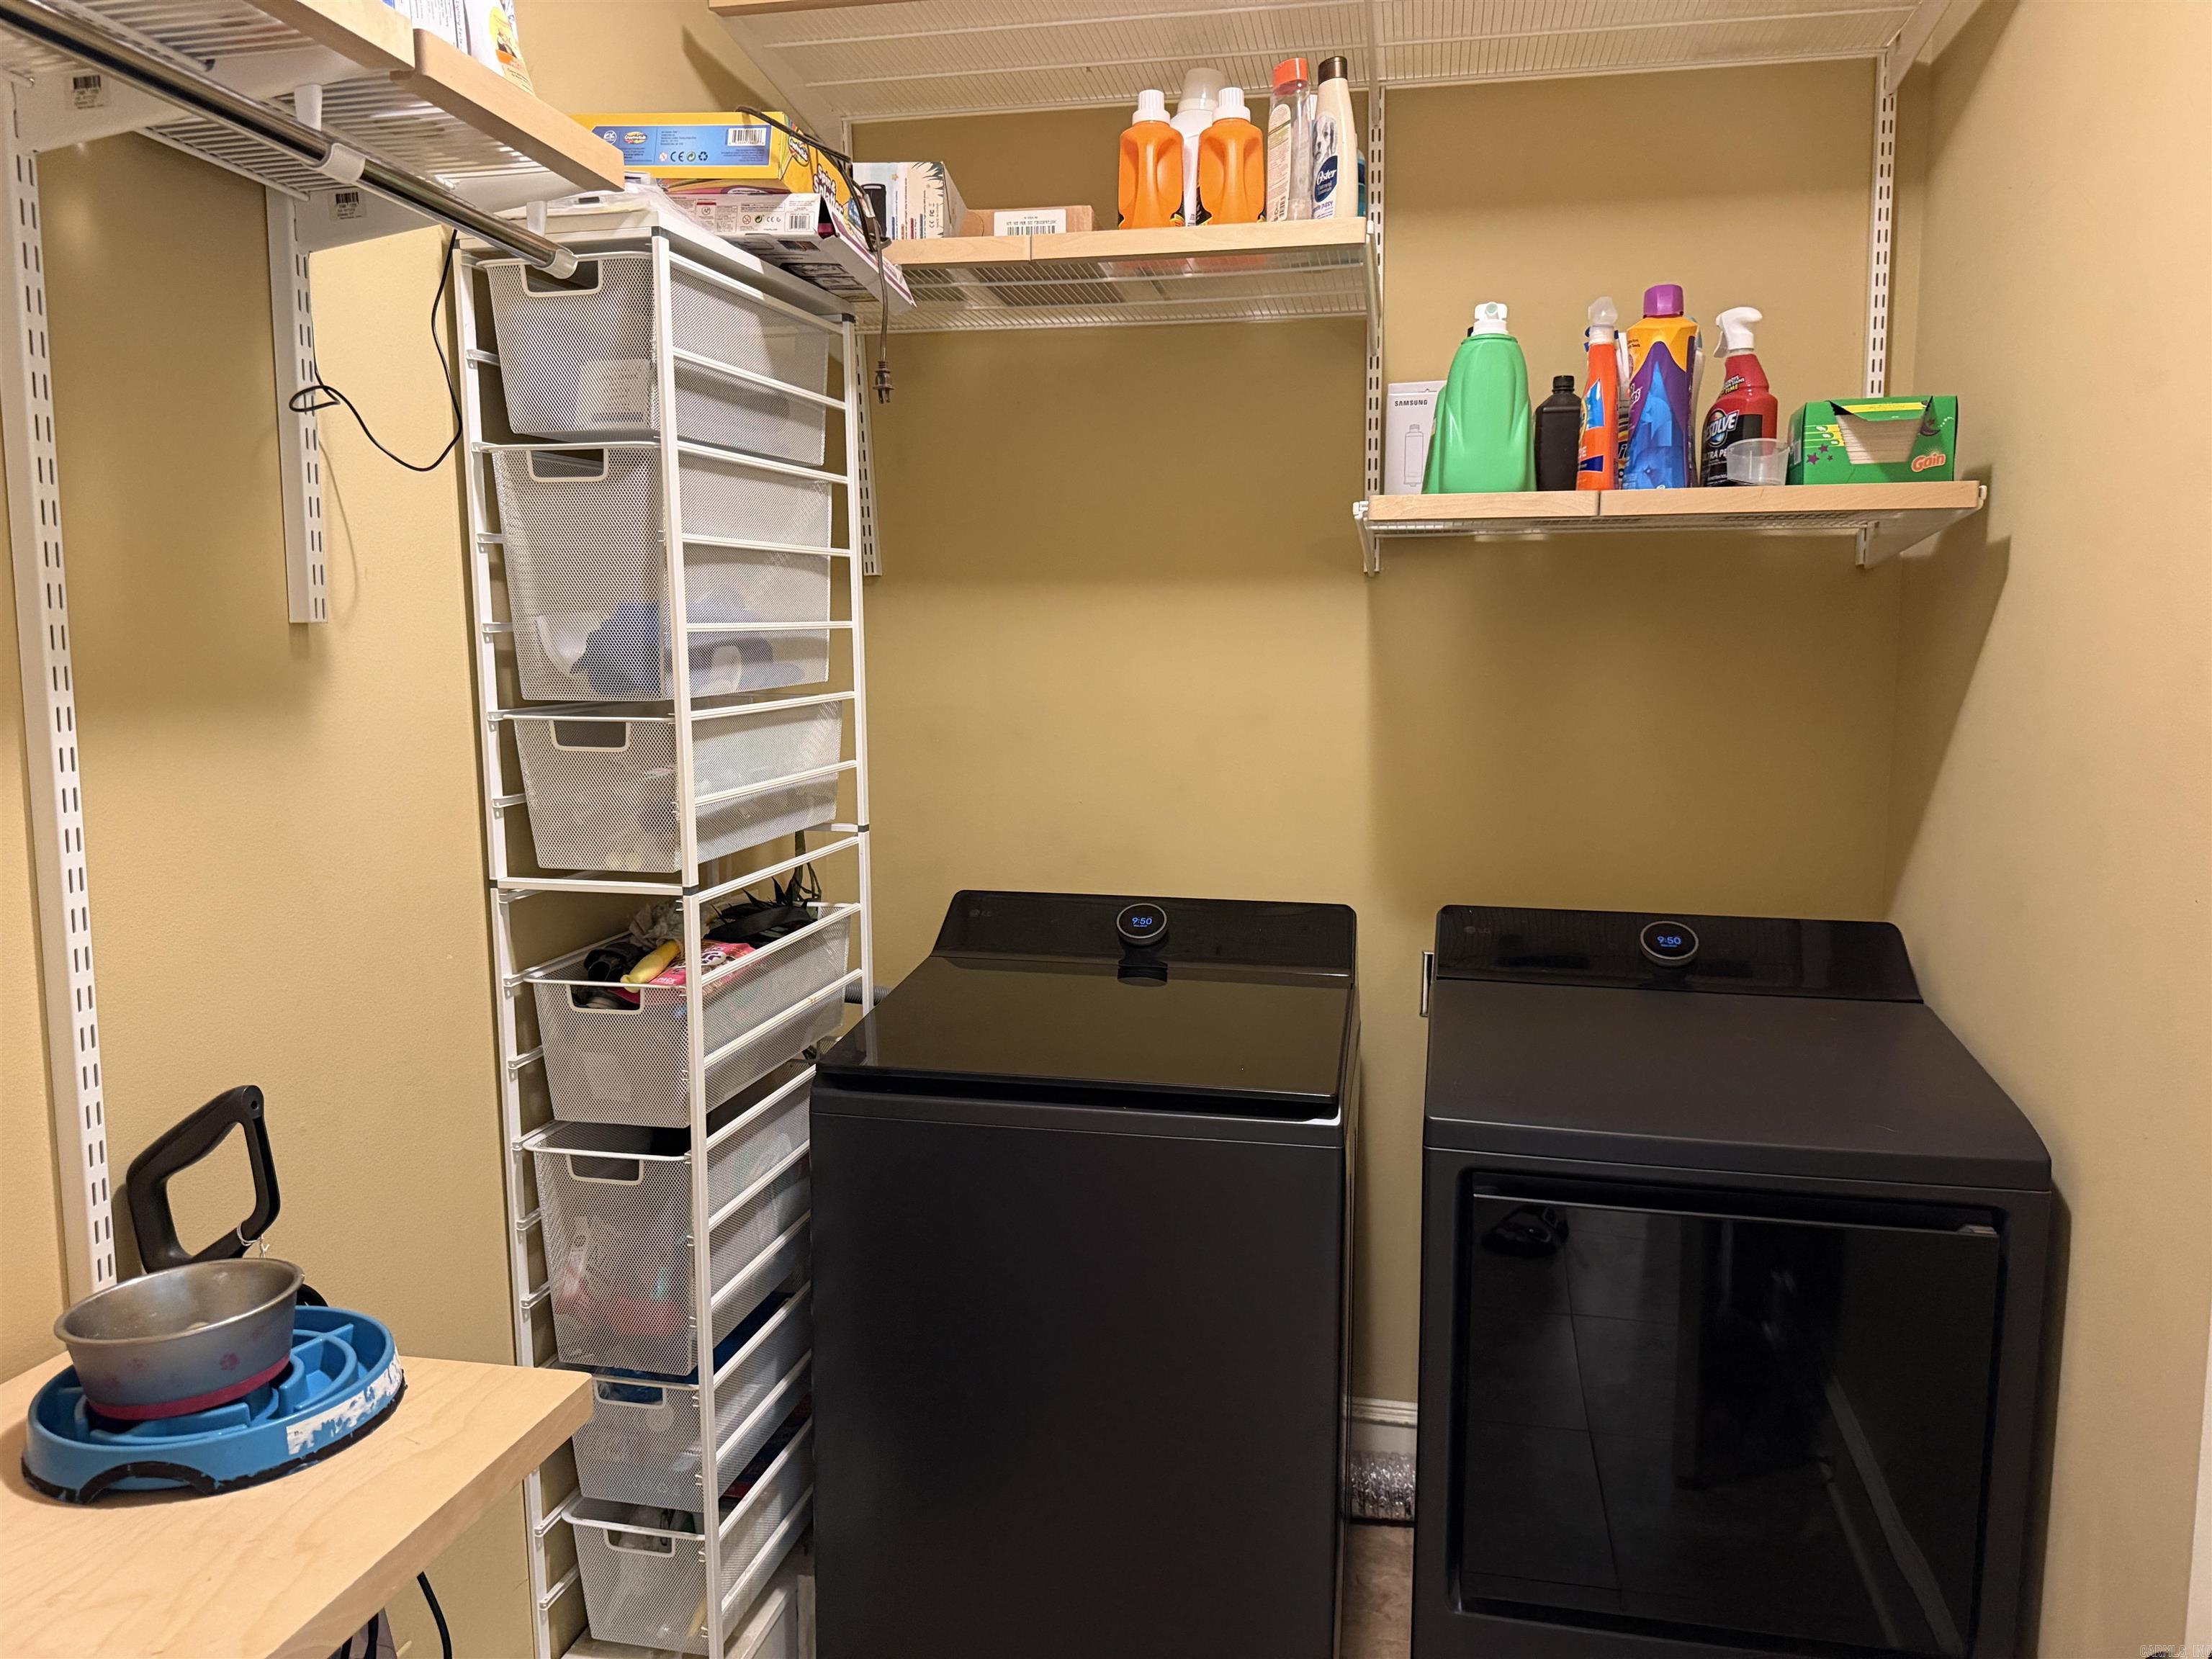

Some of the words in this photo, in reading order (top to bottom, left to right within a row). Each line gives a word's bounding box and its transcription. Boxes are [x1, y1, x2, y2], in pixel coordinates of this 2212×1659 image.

[818, 164, 832, 189] Spin
[1316, 169, 1337, 186] Oster
[814, 174, 844, 215] Splatter
[1725, 384, 1738, 394] TIME
[1706, 413, 1737, 436] SOLVE
[1912, 454, 1946, 472] Gain
[1132, 917, 1153, 925] 9:50
[1657, 936, 1681, 945] 9:50
